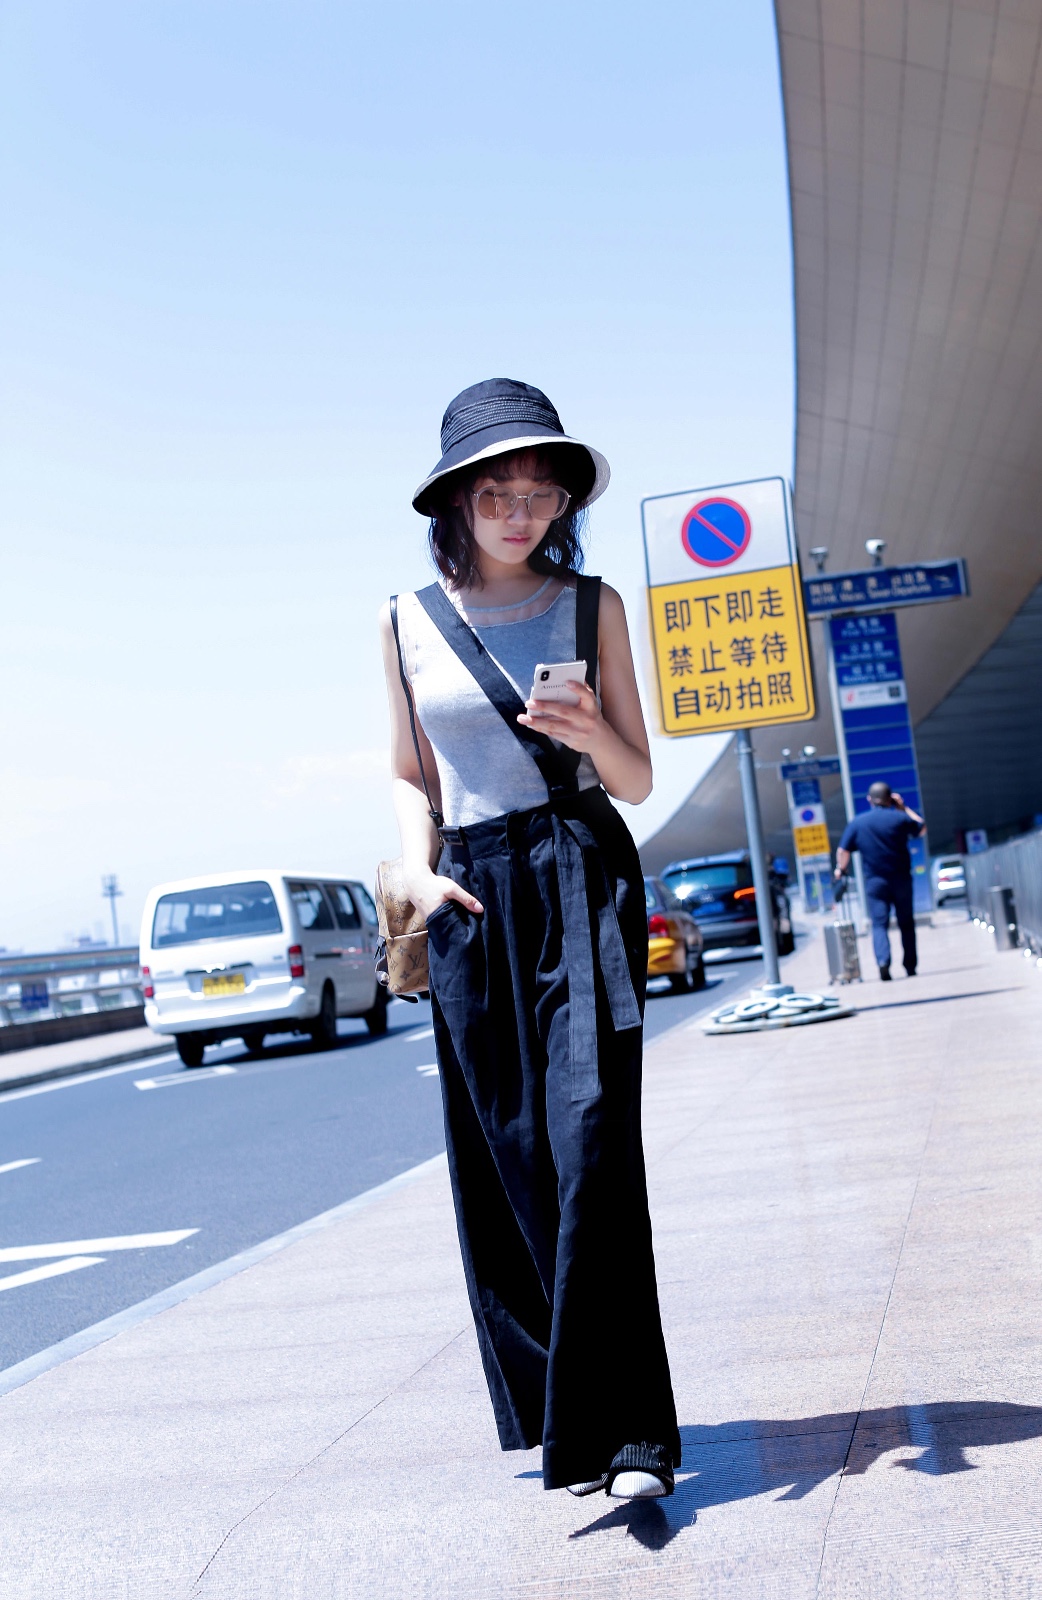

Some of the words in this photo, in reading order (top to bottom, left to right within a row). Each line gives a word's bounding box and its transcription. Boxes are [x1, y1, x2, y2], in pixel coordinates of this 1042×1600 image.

[664, 586, 785, 632] 即下即走
[668, 631, 788, 677] 禁止等待
[673, 671, 795, 719] 自动拍照
